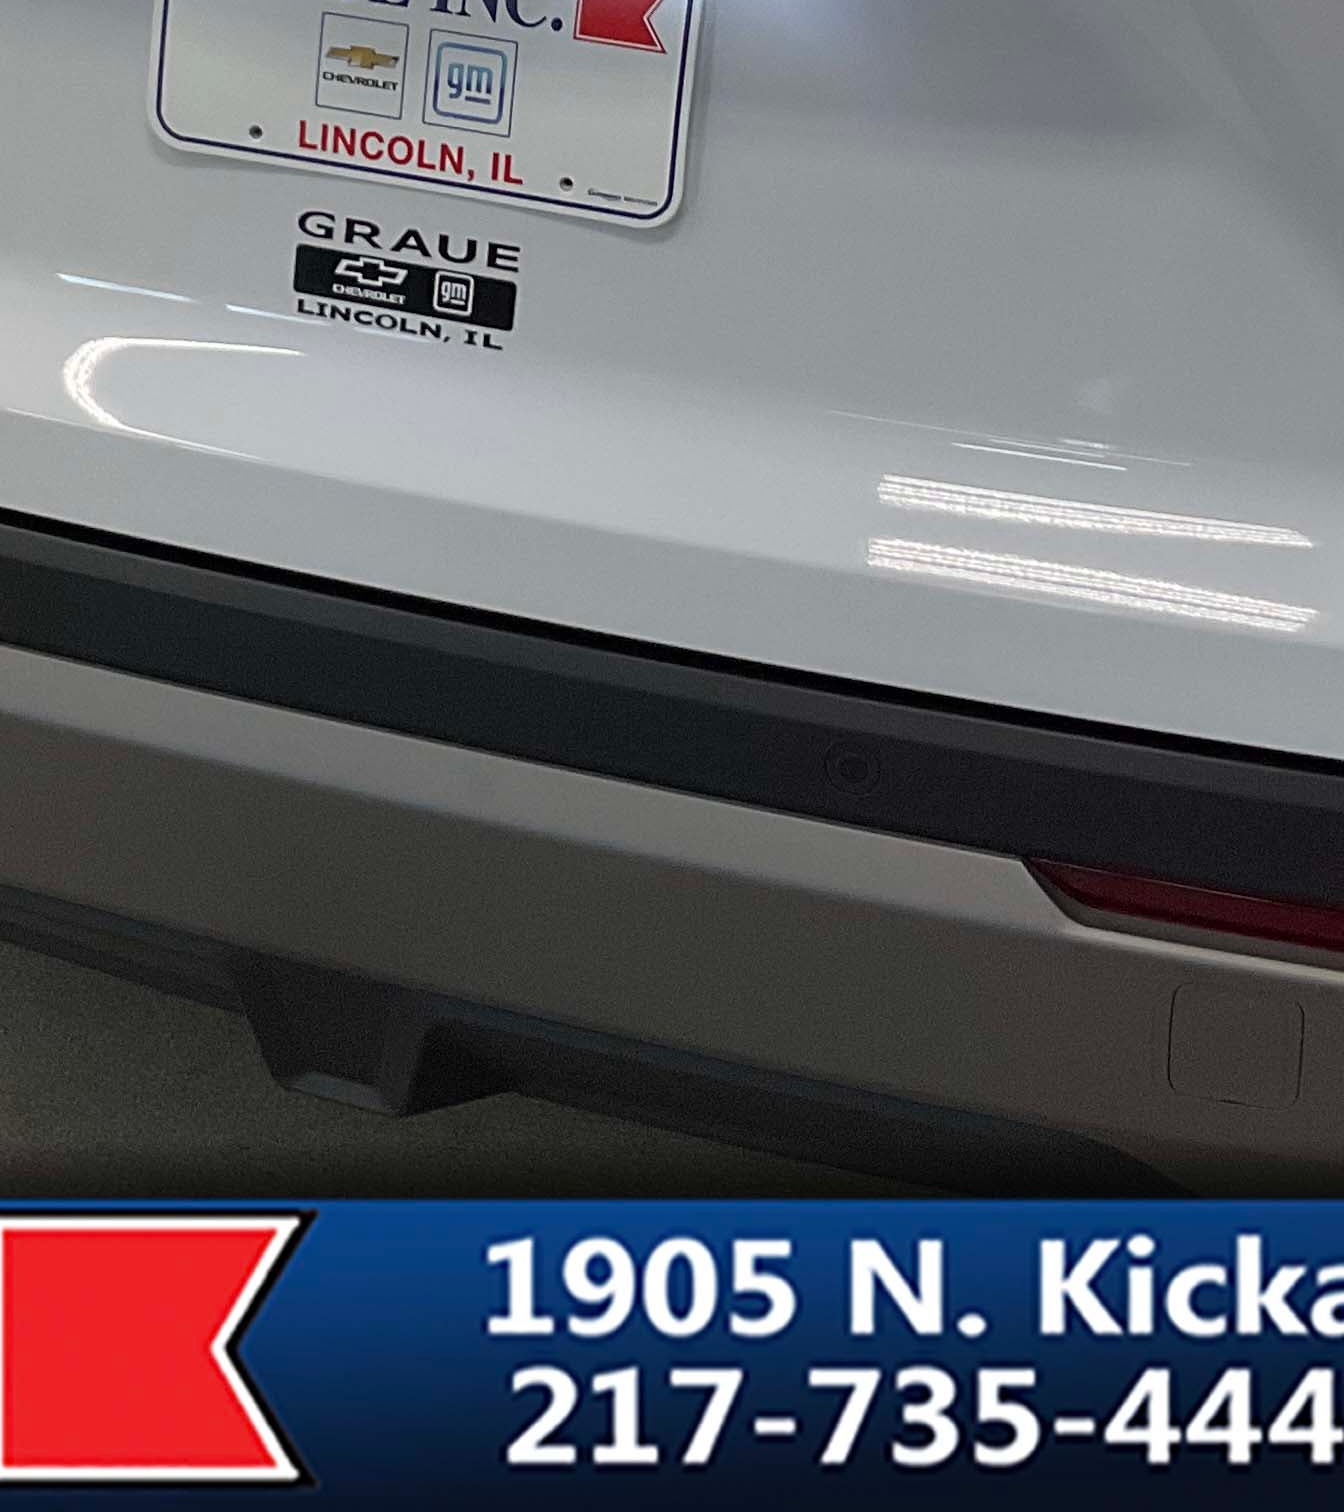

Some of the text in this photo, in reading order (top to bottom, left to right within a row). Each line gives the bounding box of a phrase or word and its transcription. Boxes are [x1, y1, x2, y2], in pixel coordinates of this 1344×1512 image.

[323, 71, 398, 91] CHEVROLET
[447, 62, 494, 105] gm
[299, 120, 523, 185] LINCOLN, IL
[298, 211, 520, 272] GRAUE
[332, 283, 406, 305] CHEVROLET
[441, 281, 467, 305] gm
[297, 299, 503, 350] LINCOLN, IL
